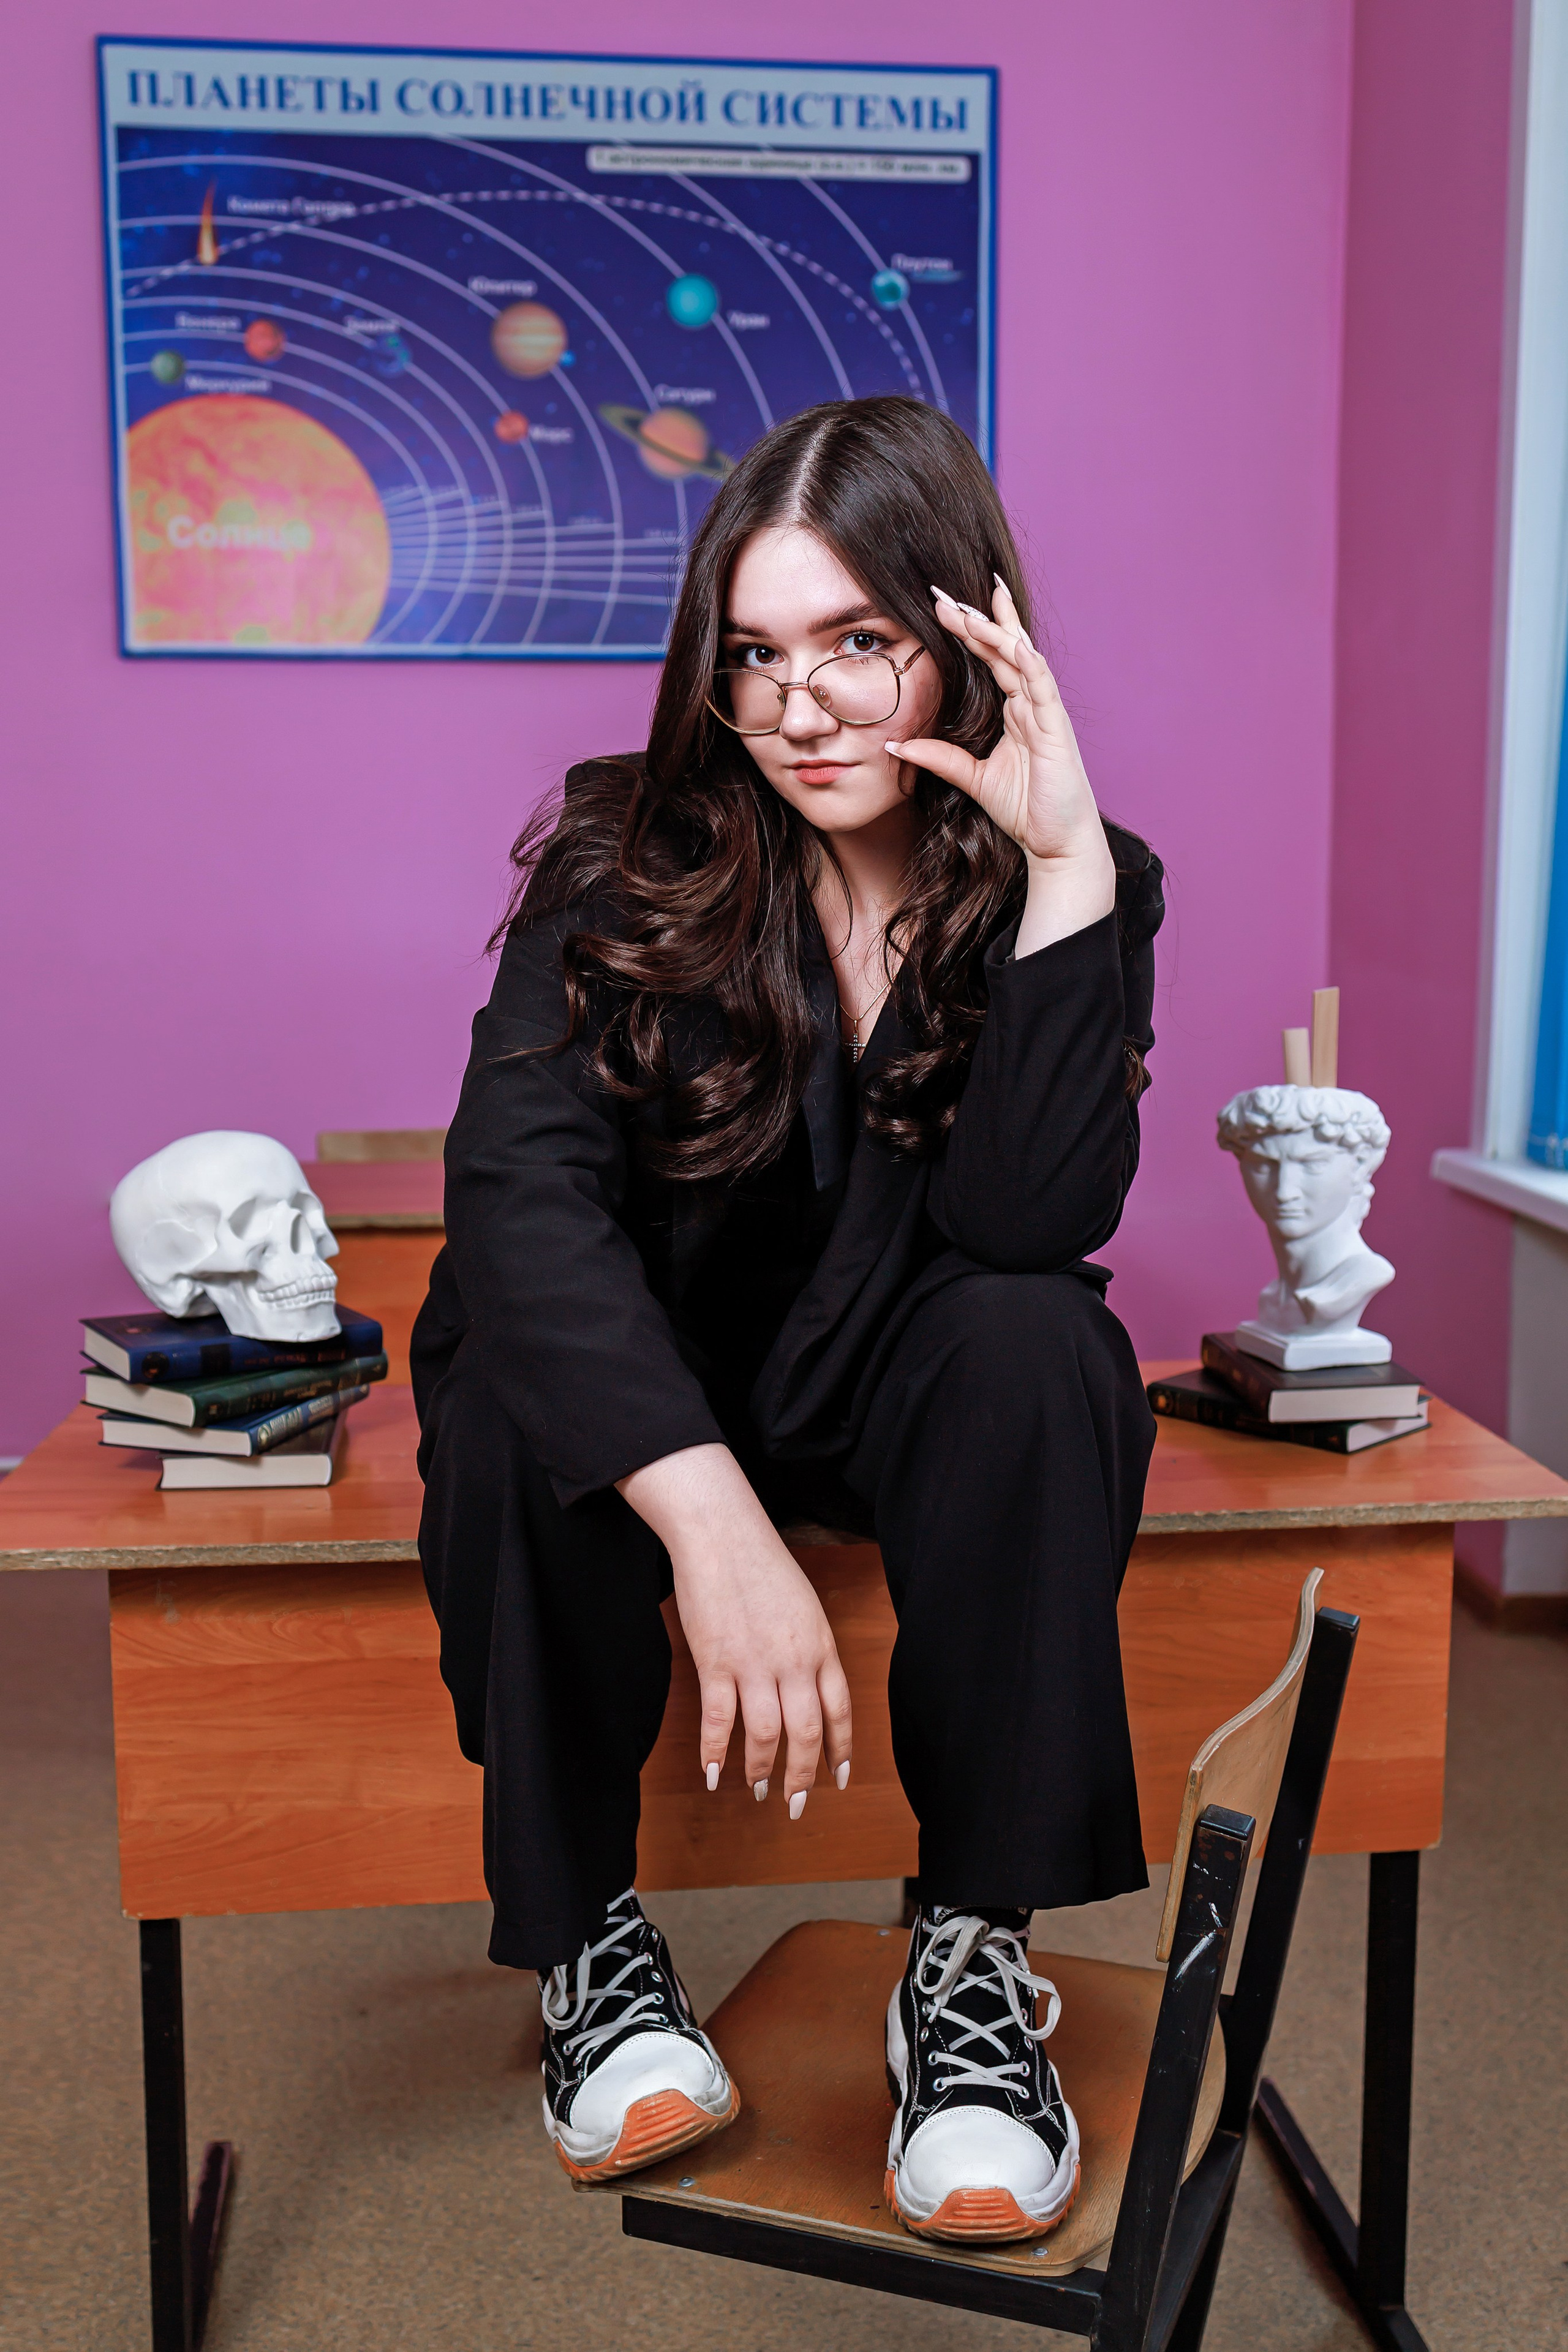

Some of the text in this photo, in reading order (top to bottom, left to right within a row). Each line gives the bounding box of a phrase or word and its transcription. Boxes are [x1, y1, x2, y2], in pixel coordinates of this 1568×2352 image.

[126, 69, 969, 133] ПЛАНЕТЫ СОЛНЕЧНОЙ СИСТЕМЫ
[186, 374, 272, 393] Меркурий
[654, 384, 716, 404] Сатурн
[529, 424, 575, 443] Марс
[167, 516, 311, 551] Солнце
